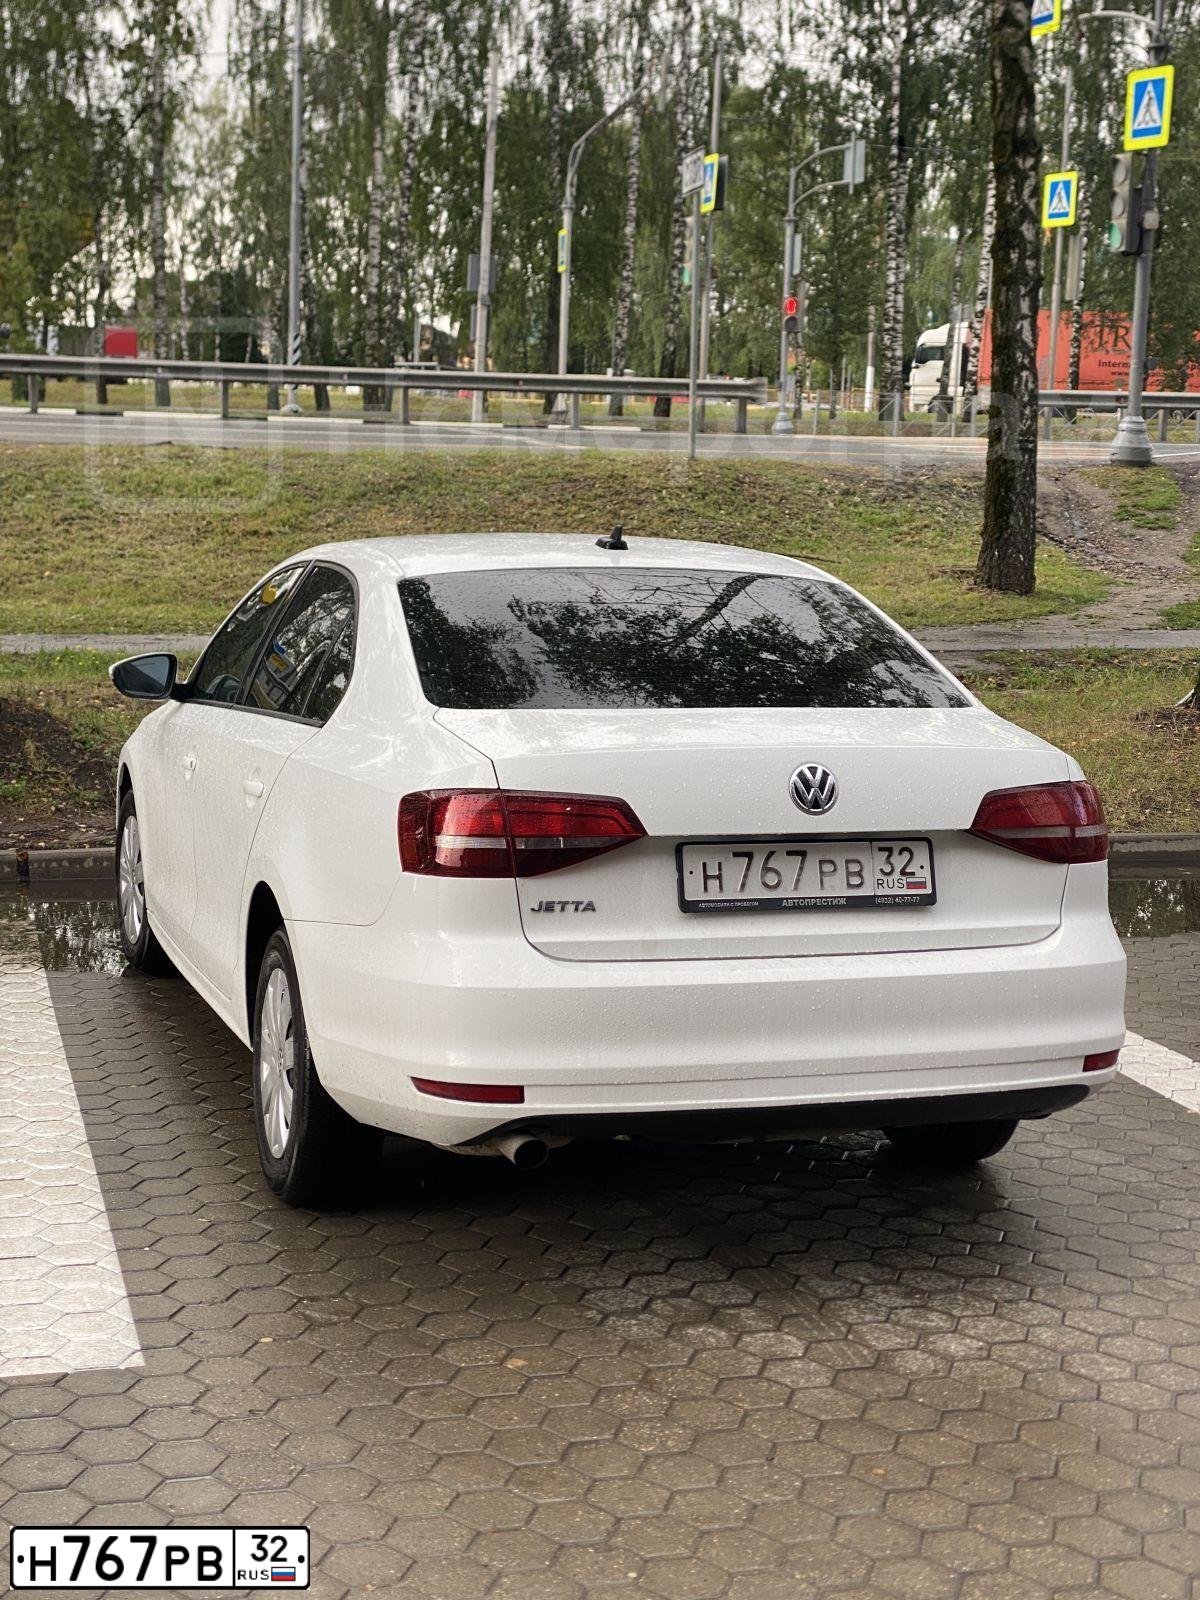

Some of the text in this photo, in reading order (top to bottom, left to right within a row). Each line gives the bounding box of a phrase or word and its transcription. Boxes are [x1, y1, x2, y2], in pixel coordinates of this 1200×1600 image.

[878, 846, 915, 876] 32
[876, 878, 905, 889] RUS
[530, 900, 597, 913] JETTA
[782, 897, 847, 907] АВТОПРЕСТИЖ
